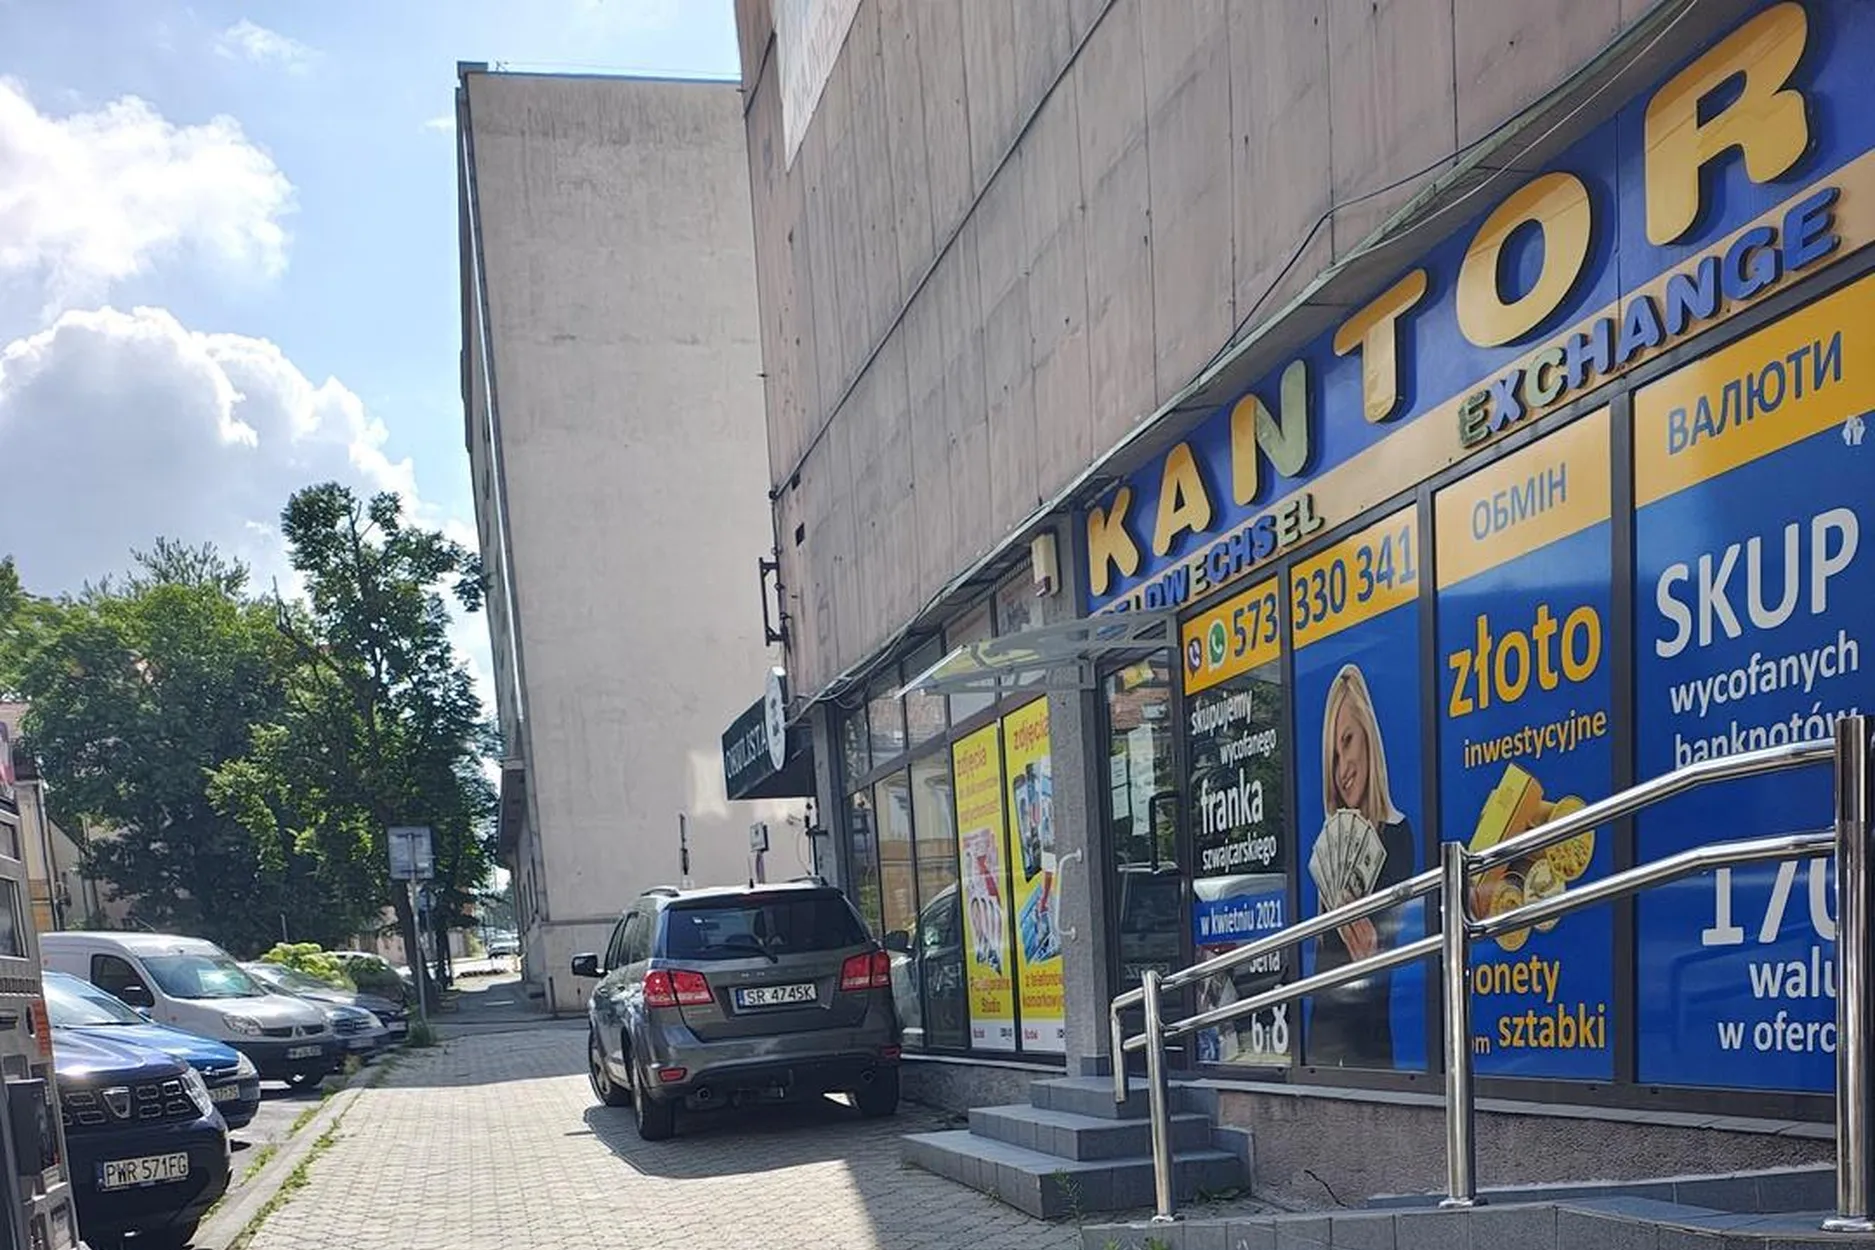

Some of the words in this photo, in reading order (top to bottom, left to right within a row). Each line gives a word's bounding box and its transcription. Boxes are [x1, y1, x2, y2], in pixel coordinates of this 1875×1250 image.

[1087, 1, 1811, 597] KANTOR
[1101, 493, 1324, 614] DWECHSEL
[1459, 186, 1841, 448] EXCHANGE
[1471, 462, 1567, 541] ОБМІН
[1667, 331, 1842, 455] ВАЛЮТИ
[1232, 592, 1278, 657] 573
[1294, 558, 1347, 631] 330
[1355, 524, 1416, 603] 341
[1654, 508, 1860, 659] SKUP
[1448, 604, 1601, 718] złoto
[1669, 629, 1859, 719] wycofanych
[1191, 690, 1253, 736] skupujemy
[1464, 709, 1607, 769] inwestycyjne
[1219, 727, 1277, 767] wycofanego
[1200, 767, 1264, 835] franka
[1202, 831, 1277, 873] szwajcarskiego
[1200, 916, 1210, 937] w
[1211, 902, 1254, 936] kwietniu
[1256, 899, 1284, 930] 2021
[746, 988, 766, 1005] SR
[1471, 954, 1561, 1004] onety
[1498, 1003, 1605, 1048] sztabki
[1717, 1021, 1745, 1050] w
[1753, 1010, 1838, 1053] oferc
[105, 1160, 138, 1185] PWR
[141, 1154, 187, 1180] 571FG
